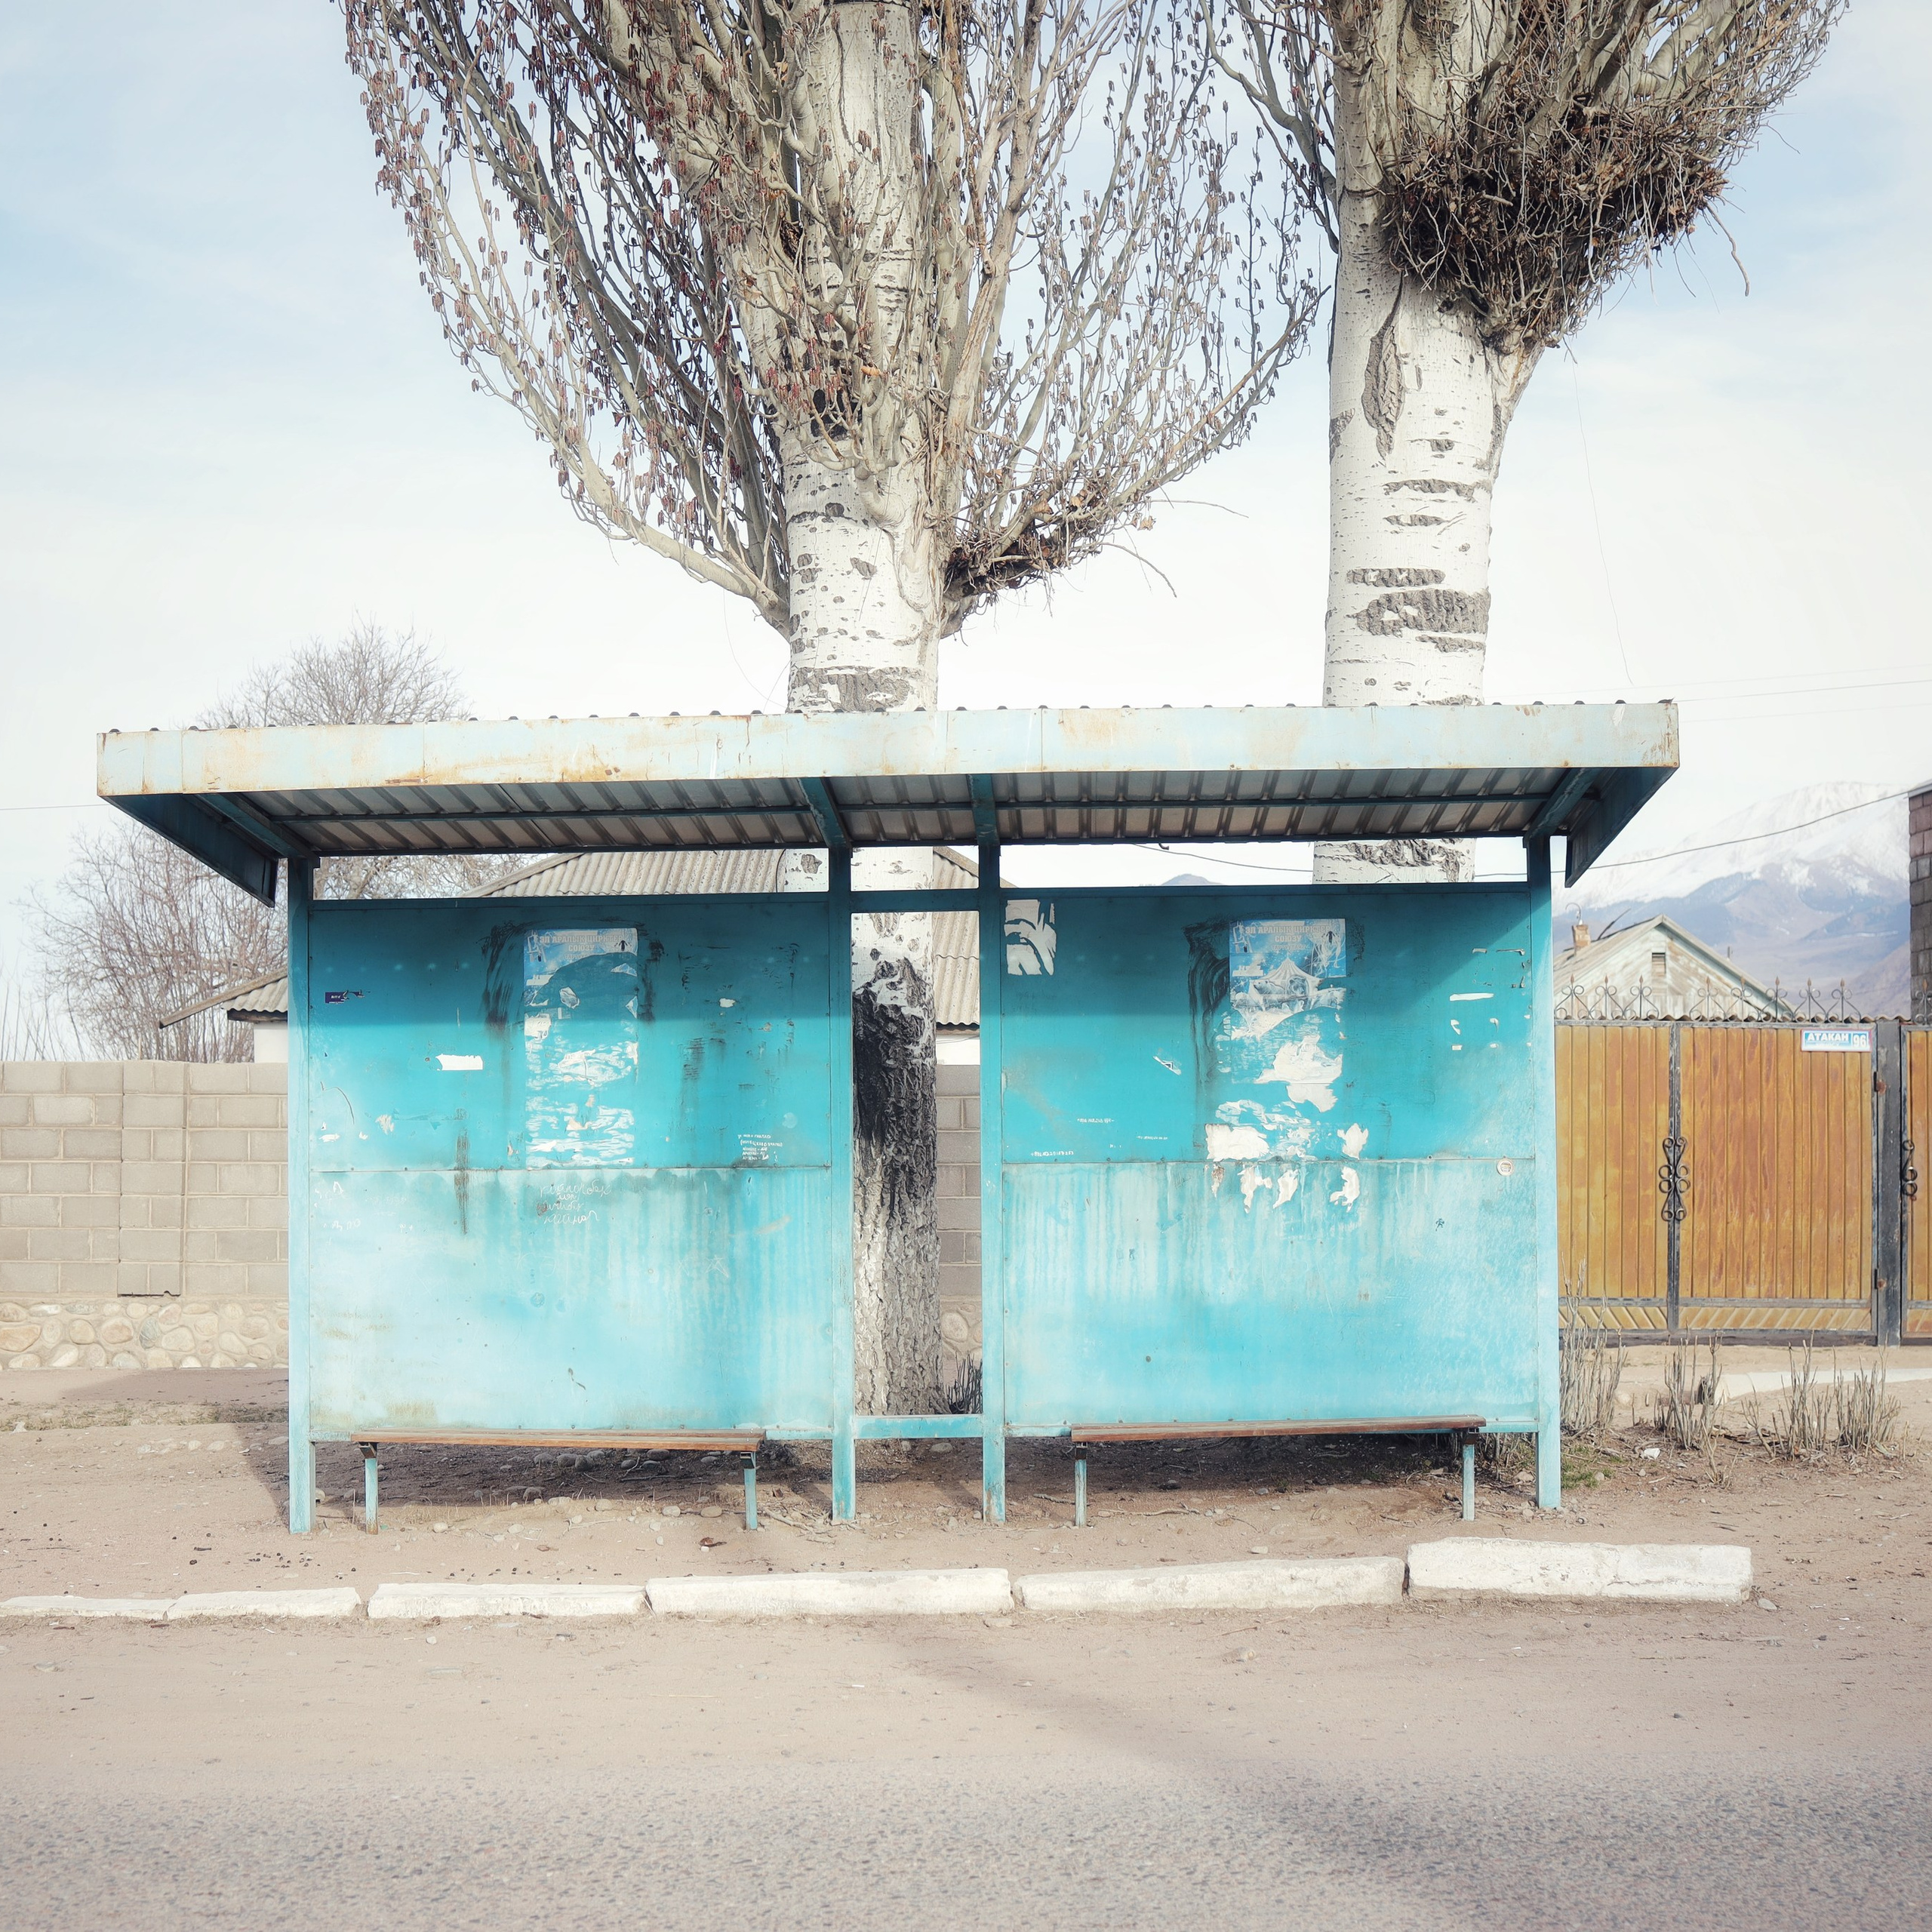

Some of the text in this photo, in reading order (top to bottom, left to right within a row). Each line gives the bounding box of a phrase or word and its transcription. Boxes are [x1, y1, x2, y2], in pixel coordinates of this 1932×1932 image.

[1275, 934, 1302, 943] СОЮЗУ
[1807, 1032, 1849, 1041] АТАКАН
[1853, 1034, 1867, 1048] 96
